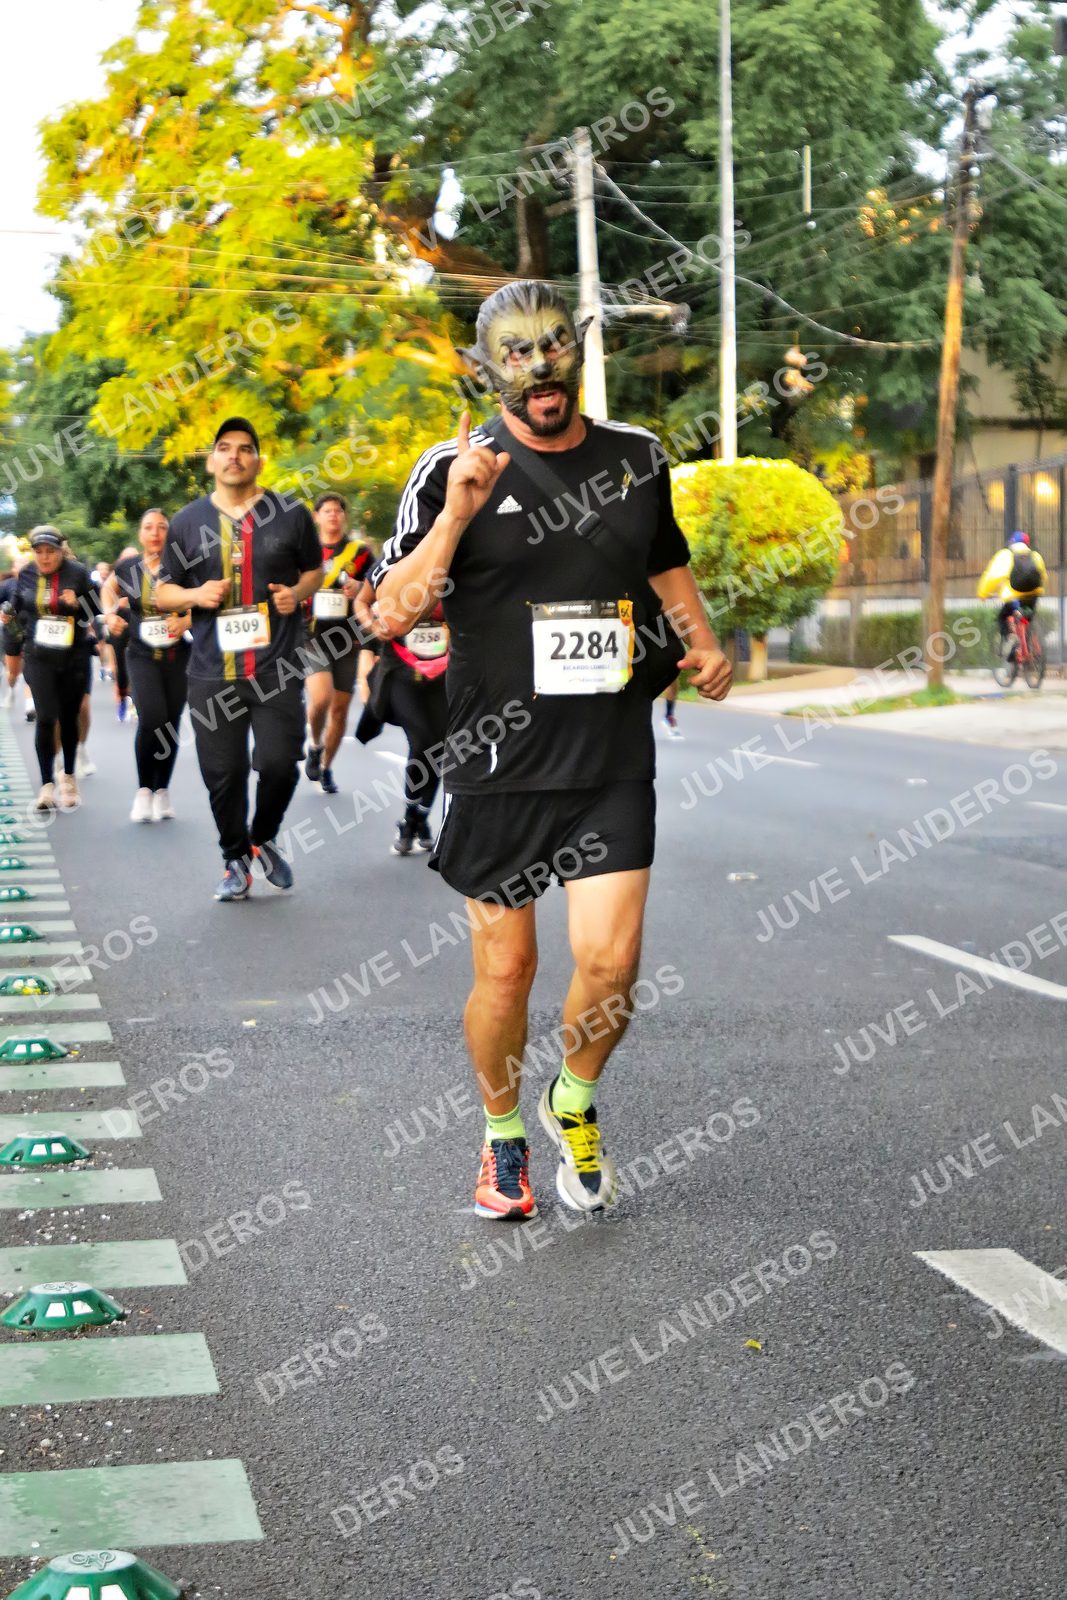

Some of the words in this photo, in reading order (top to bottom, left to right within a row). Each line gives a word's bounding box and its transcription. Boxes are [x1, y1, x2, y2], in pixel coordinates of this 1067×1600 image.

[43, 624, 65, 634] 7827
[148, 624, 170, 636] 258
[225, 618, 259, 634] 4309
[413, 631, 441, 643] 7558
[550, 631, 618, 660] 2284
